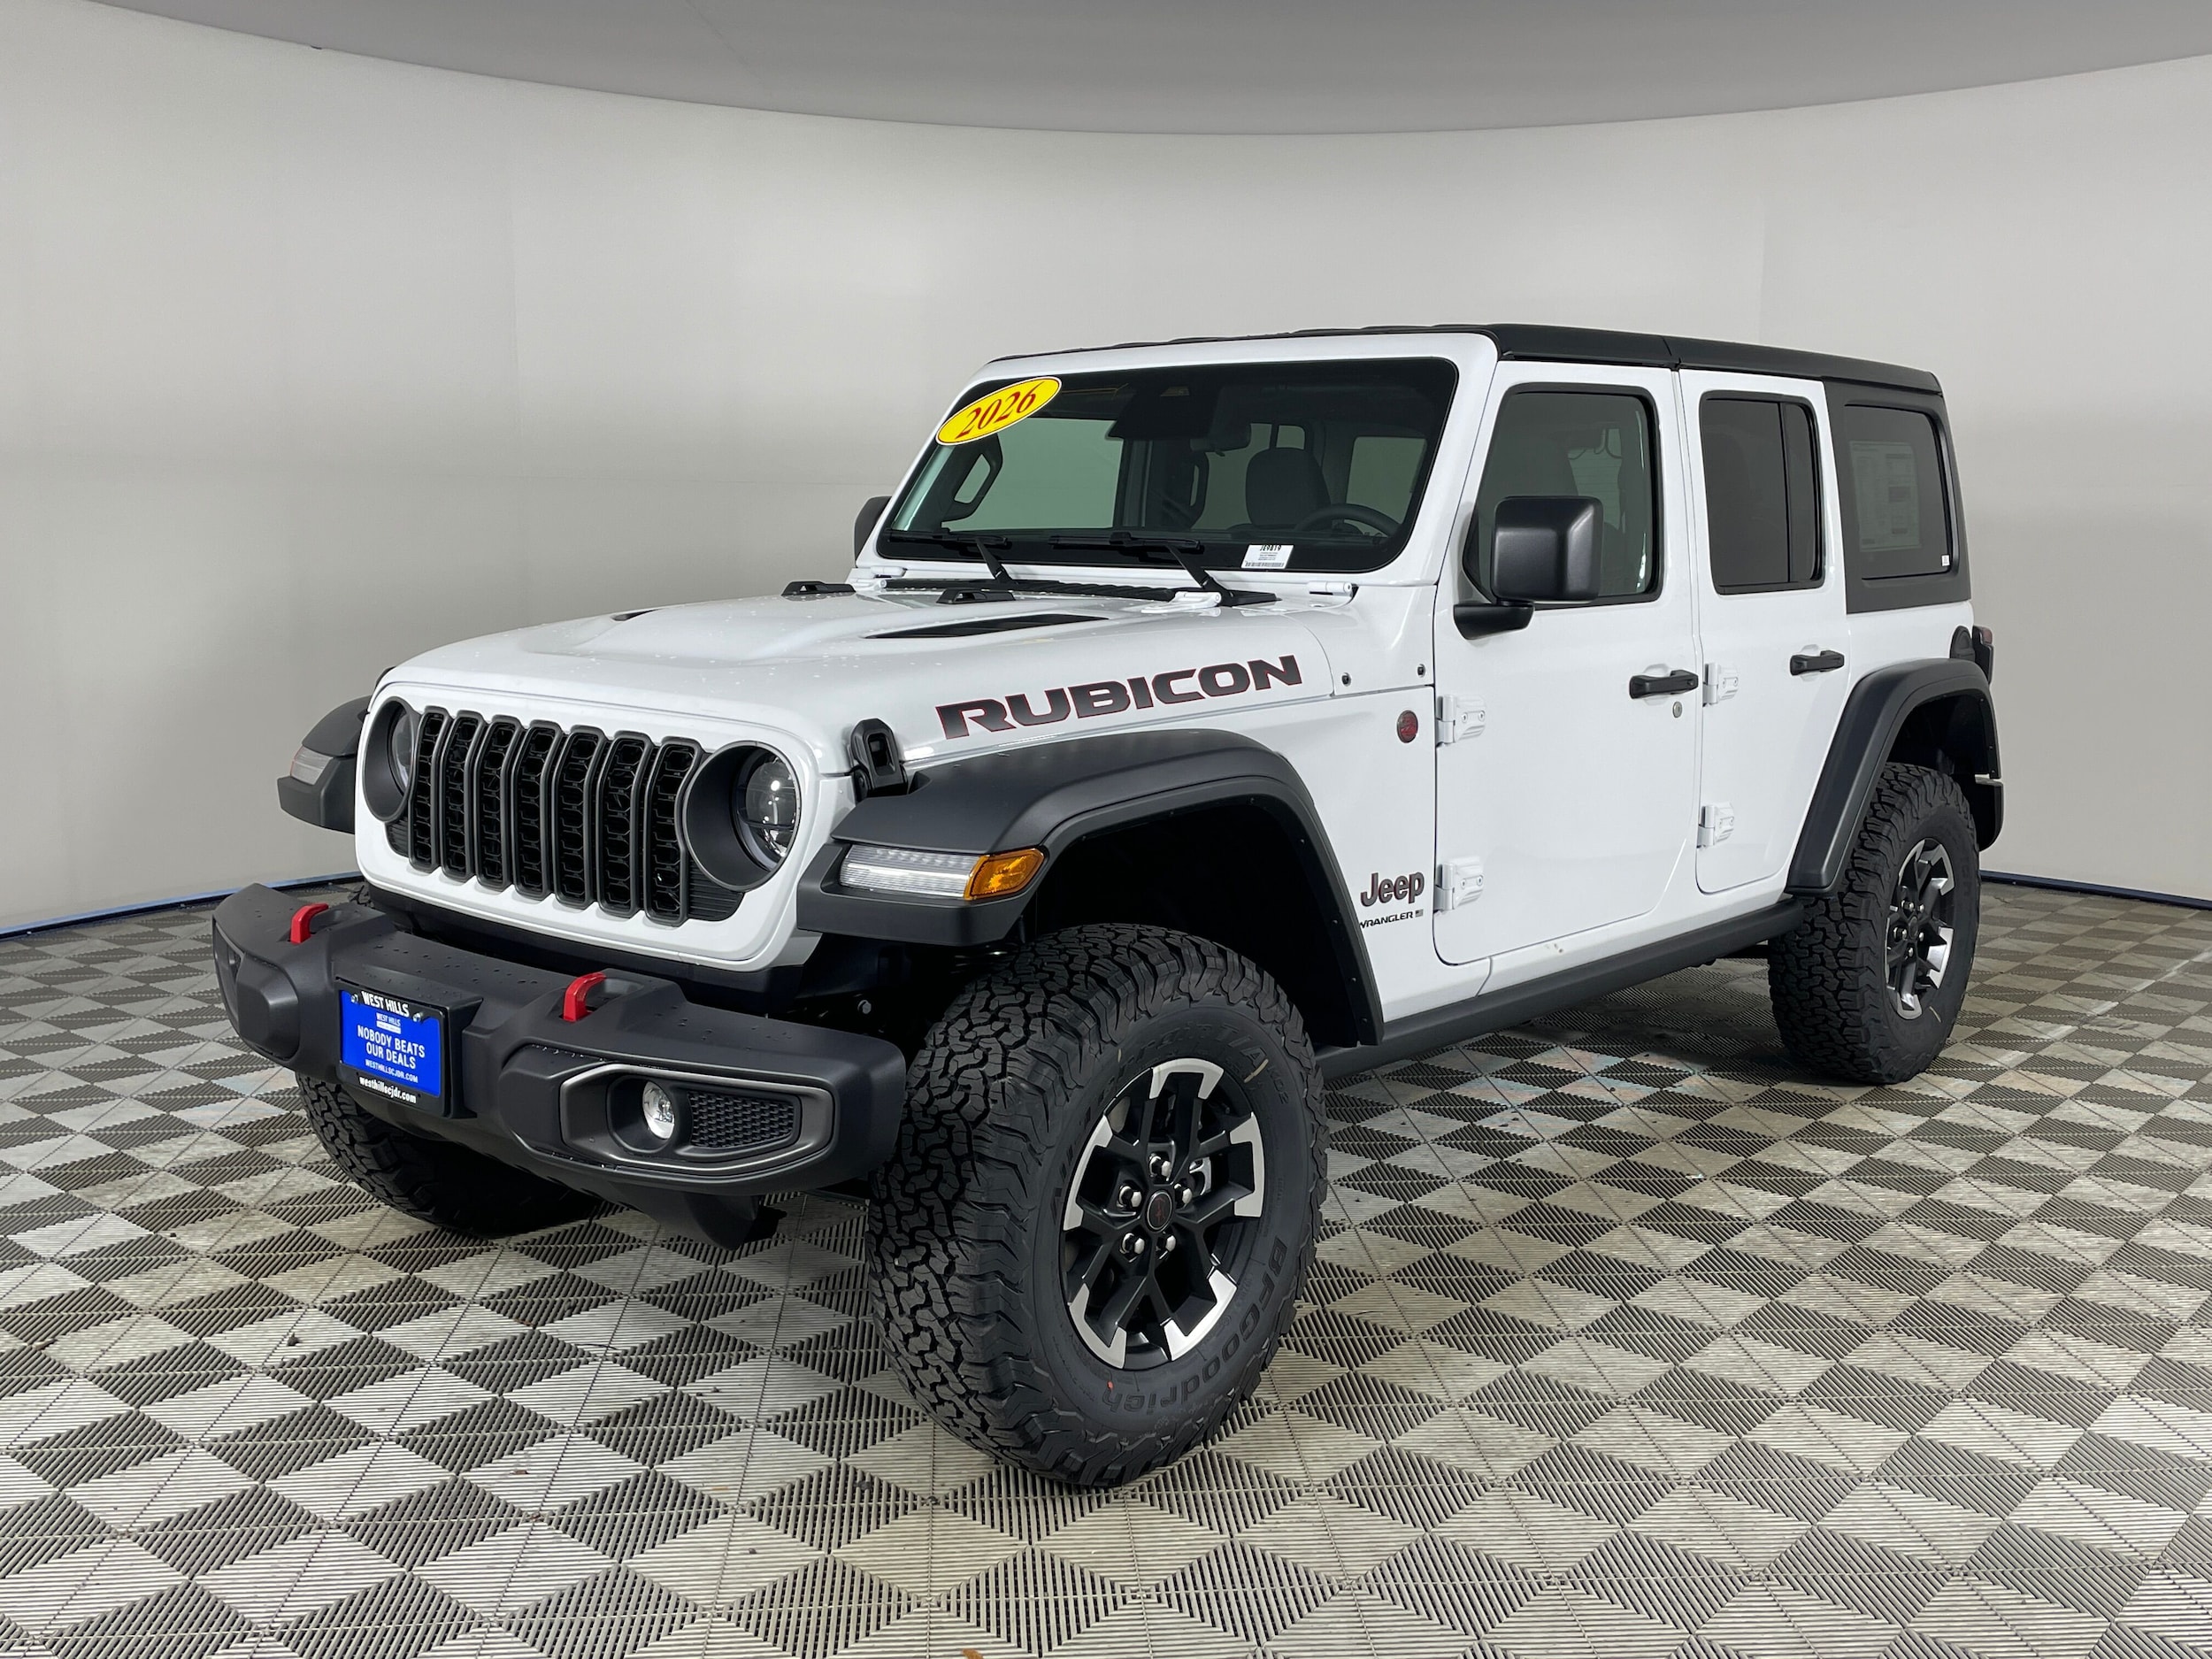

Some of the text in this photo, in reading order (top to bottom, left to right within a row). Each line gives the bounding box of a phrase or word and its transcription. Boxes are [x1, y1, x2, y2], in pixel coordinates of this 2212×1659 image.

[954, 380, 1045, 440] 2026
[935, 655, 1302, 740] RUBICON
[1360, 872, 1425, 907] Jeep
[361, 990, 410, 1018] WEST HILLS
[376, 1012, 388, 1022] WEST
[388, 1016, 401, 1027] HILLS
[357, 1025, 392, 1048] NOBODY
[395, 1038, 426, 1058] BEATS
[365, 1041, 416, 1069] OUR DEALS
[359, 1076, 417, 1103] westhillscjdr.com
[1102, 1236, 1288, 1416] BFGoodrich
